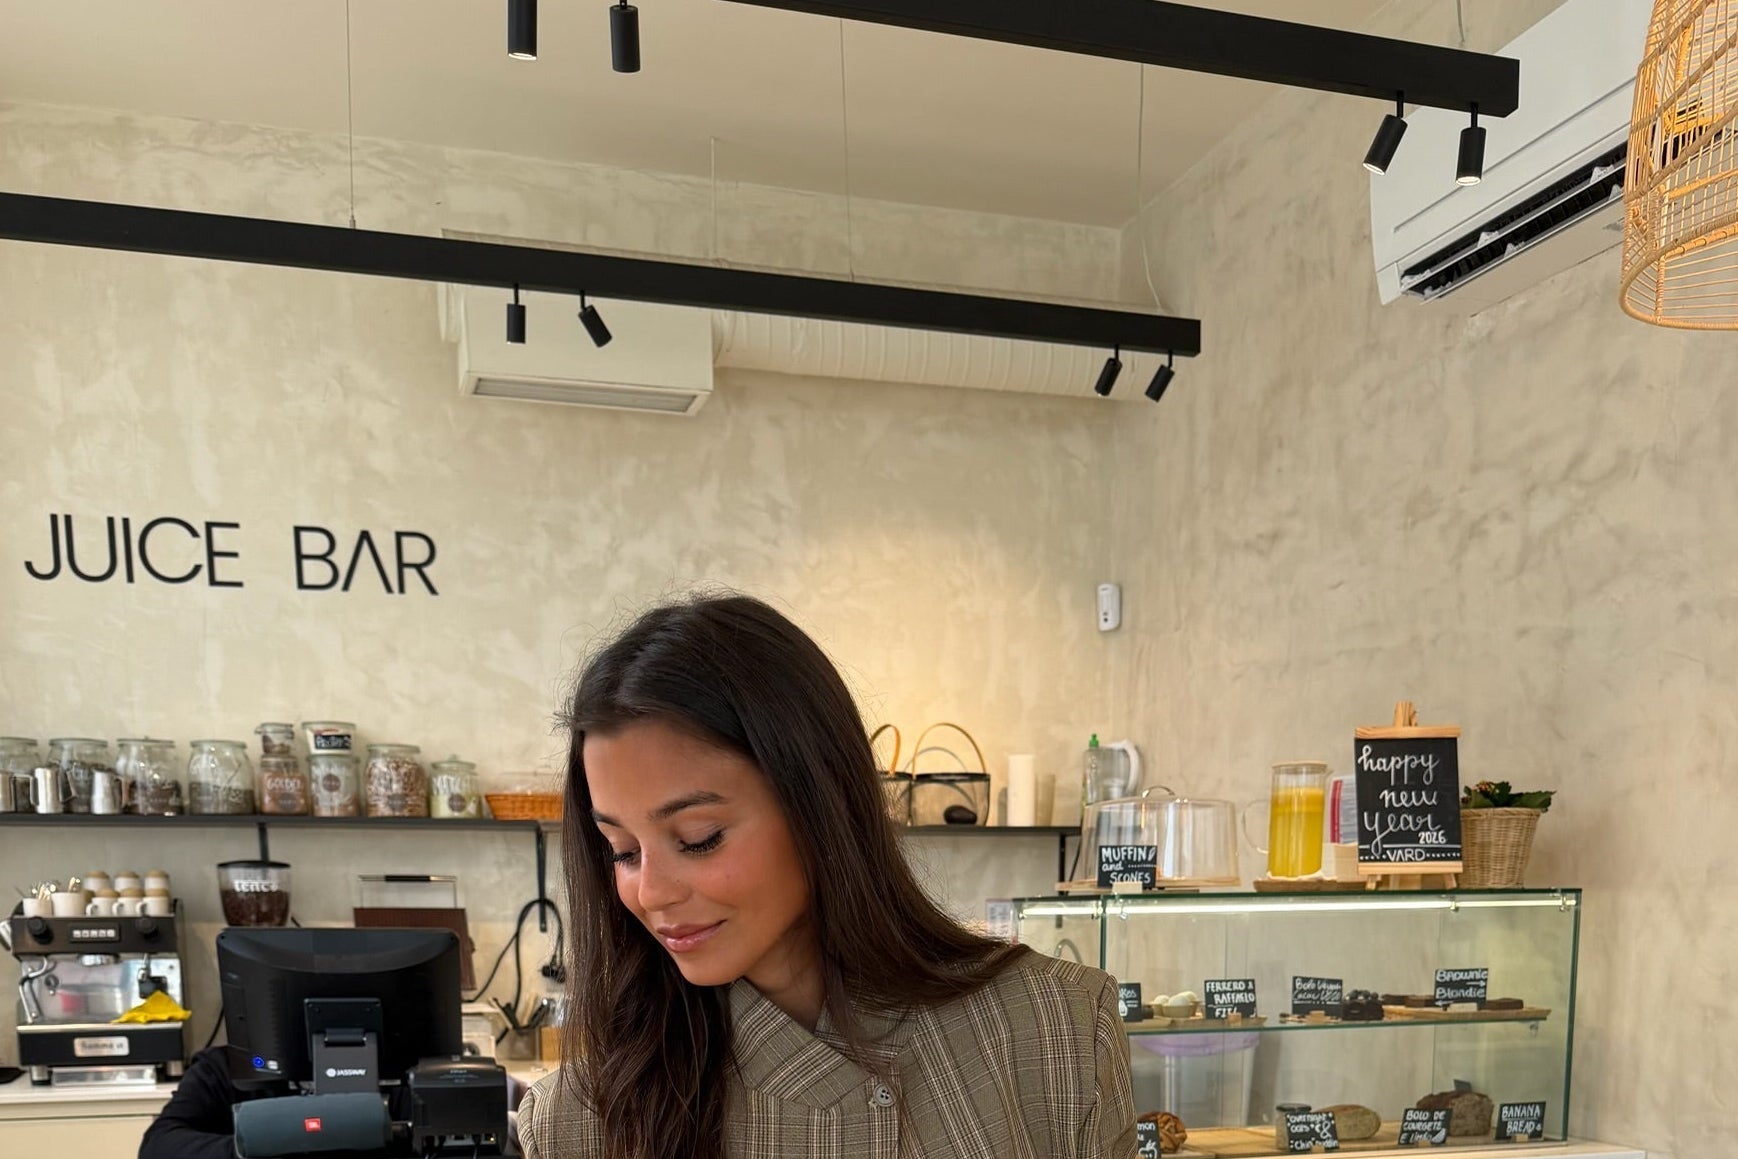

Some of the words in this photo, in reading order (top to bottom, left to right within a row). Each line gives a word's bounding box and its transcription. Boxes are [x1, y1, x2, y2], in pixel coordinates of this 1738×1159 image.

[24, 513, 244, 588] JUICE
[293, 525, 439, 596] BAR
[1357, 745, 1439, 786] happy
[1379, 789, 1438, 808] new
[1363, 812, 1442, 859] year
[1418, 830, 1447, 845] 2026
[1101, 861, 1124, 872] and
[1110, 871, 1151, 884] SCONES
[1206, 981, 1246, 993] FERRERO
[1435, 987, 1486, 1000] Blondie
[1405, 1109, 1430, 1121] BOLO
[1501, 1104, 1540, 1121] BANANA
[1506, 1120, 1536, 1137] BREAD
